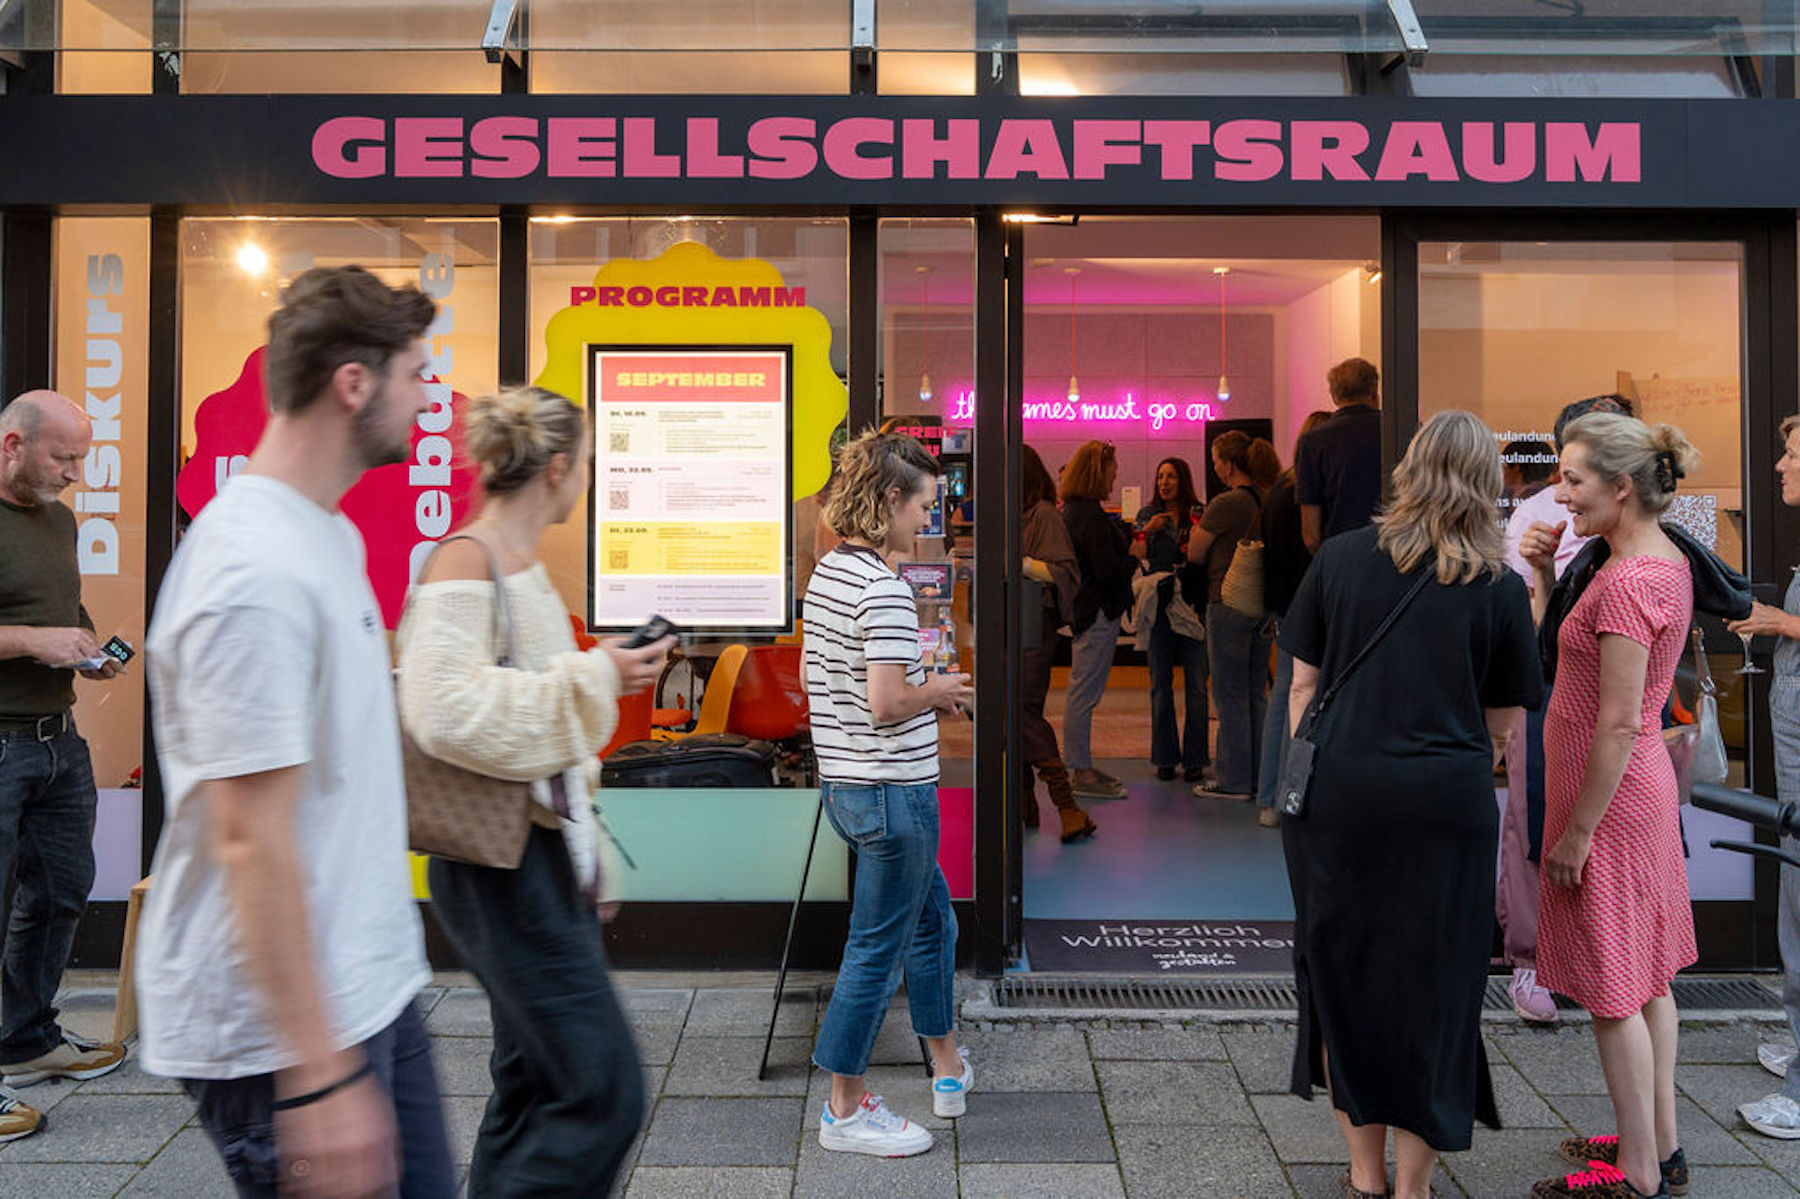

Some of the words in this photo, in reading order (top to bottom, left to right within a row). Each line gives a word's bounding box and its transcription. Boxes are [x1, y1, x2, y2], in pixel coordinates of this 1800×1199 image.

[311, 116, 1641, 183] GESELLSCHAFTSRAUM
[570, 286, 806, 307] PROGRAMM
[616, 372, 766, 387] SEPTEMBER
[75, 253, 124, 575] Diskurs
[1023, 402, 1076, 420] ames
[1081, 393, 1141, 420] must
[1148, 403, 1176, 429] go
[1185, 403, 1215, 420] on
[1099, 924, 1261, 937] Herzlich
[1061, 935, 1296, 948] Willkomme
